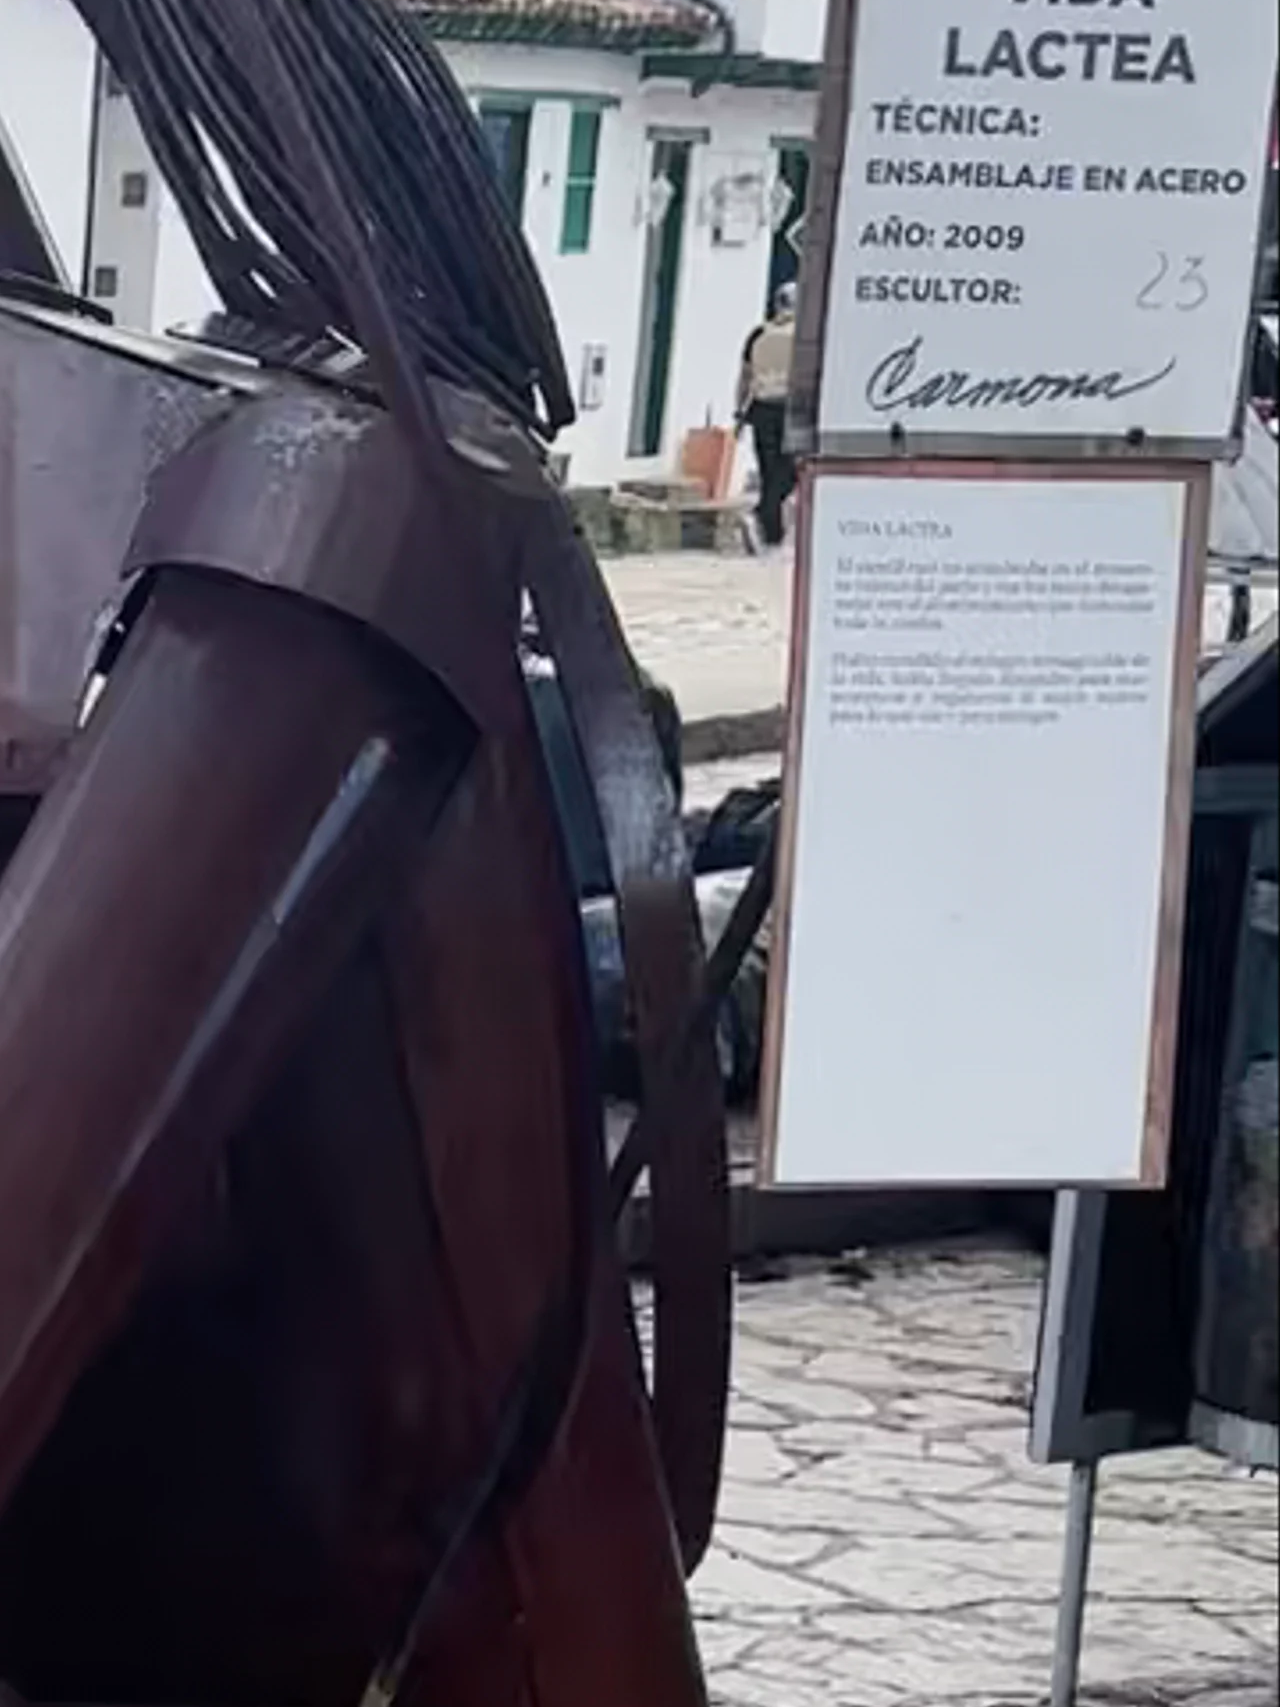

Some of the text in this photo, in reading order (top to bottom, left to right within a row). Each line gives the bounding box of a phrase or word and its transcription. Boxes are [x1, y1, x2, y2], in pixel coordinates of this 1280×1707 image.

[943, 27, 1196, 84] LACTEA
[871, 95, 1040, 137] TÉCNICA:
[865, 159, 1247, 196] ENSAMBLAJE EN ACERO
[858, 214, 1025, 250] AÑO: 2009
[854, 275, 1022, 305] ESCULTOR:
[866, 334, 1177, 412] Carmona
